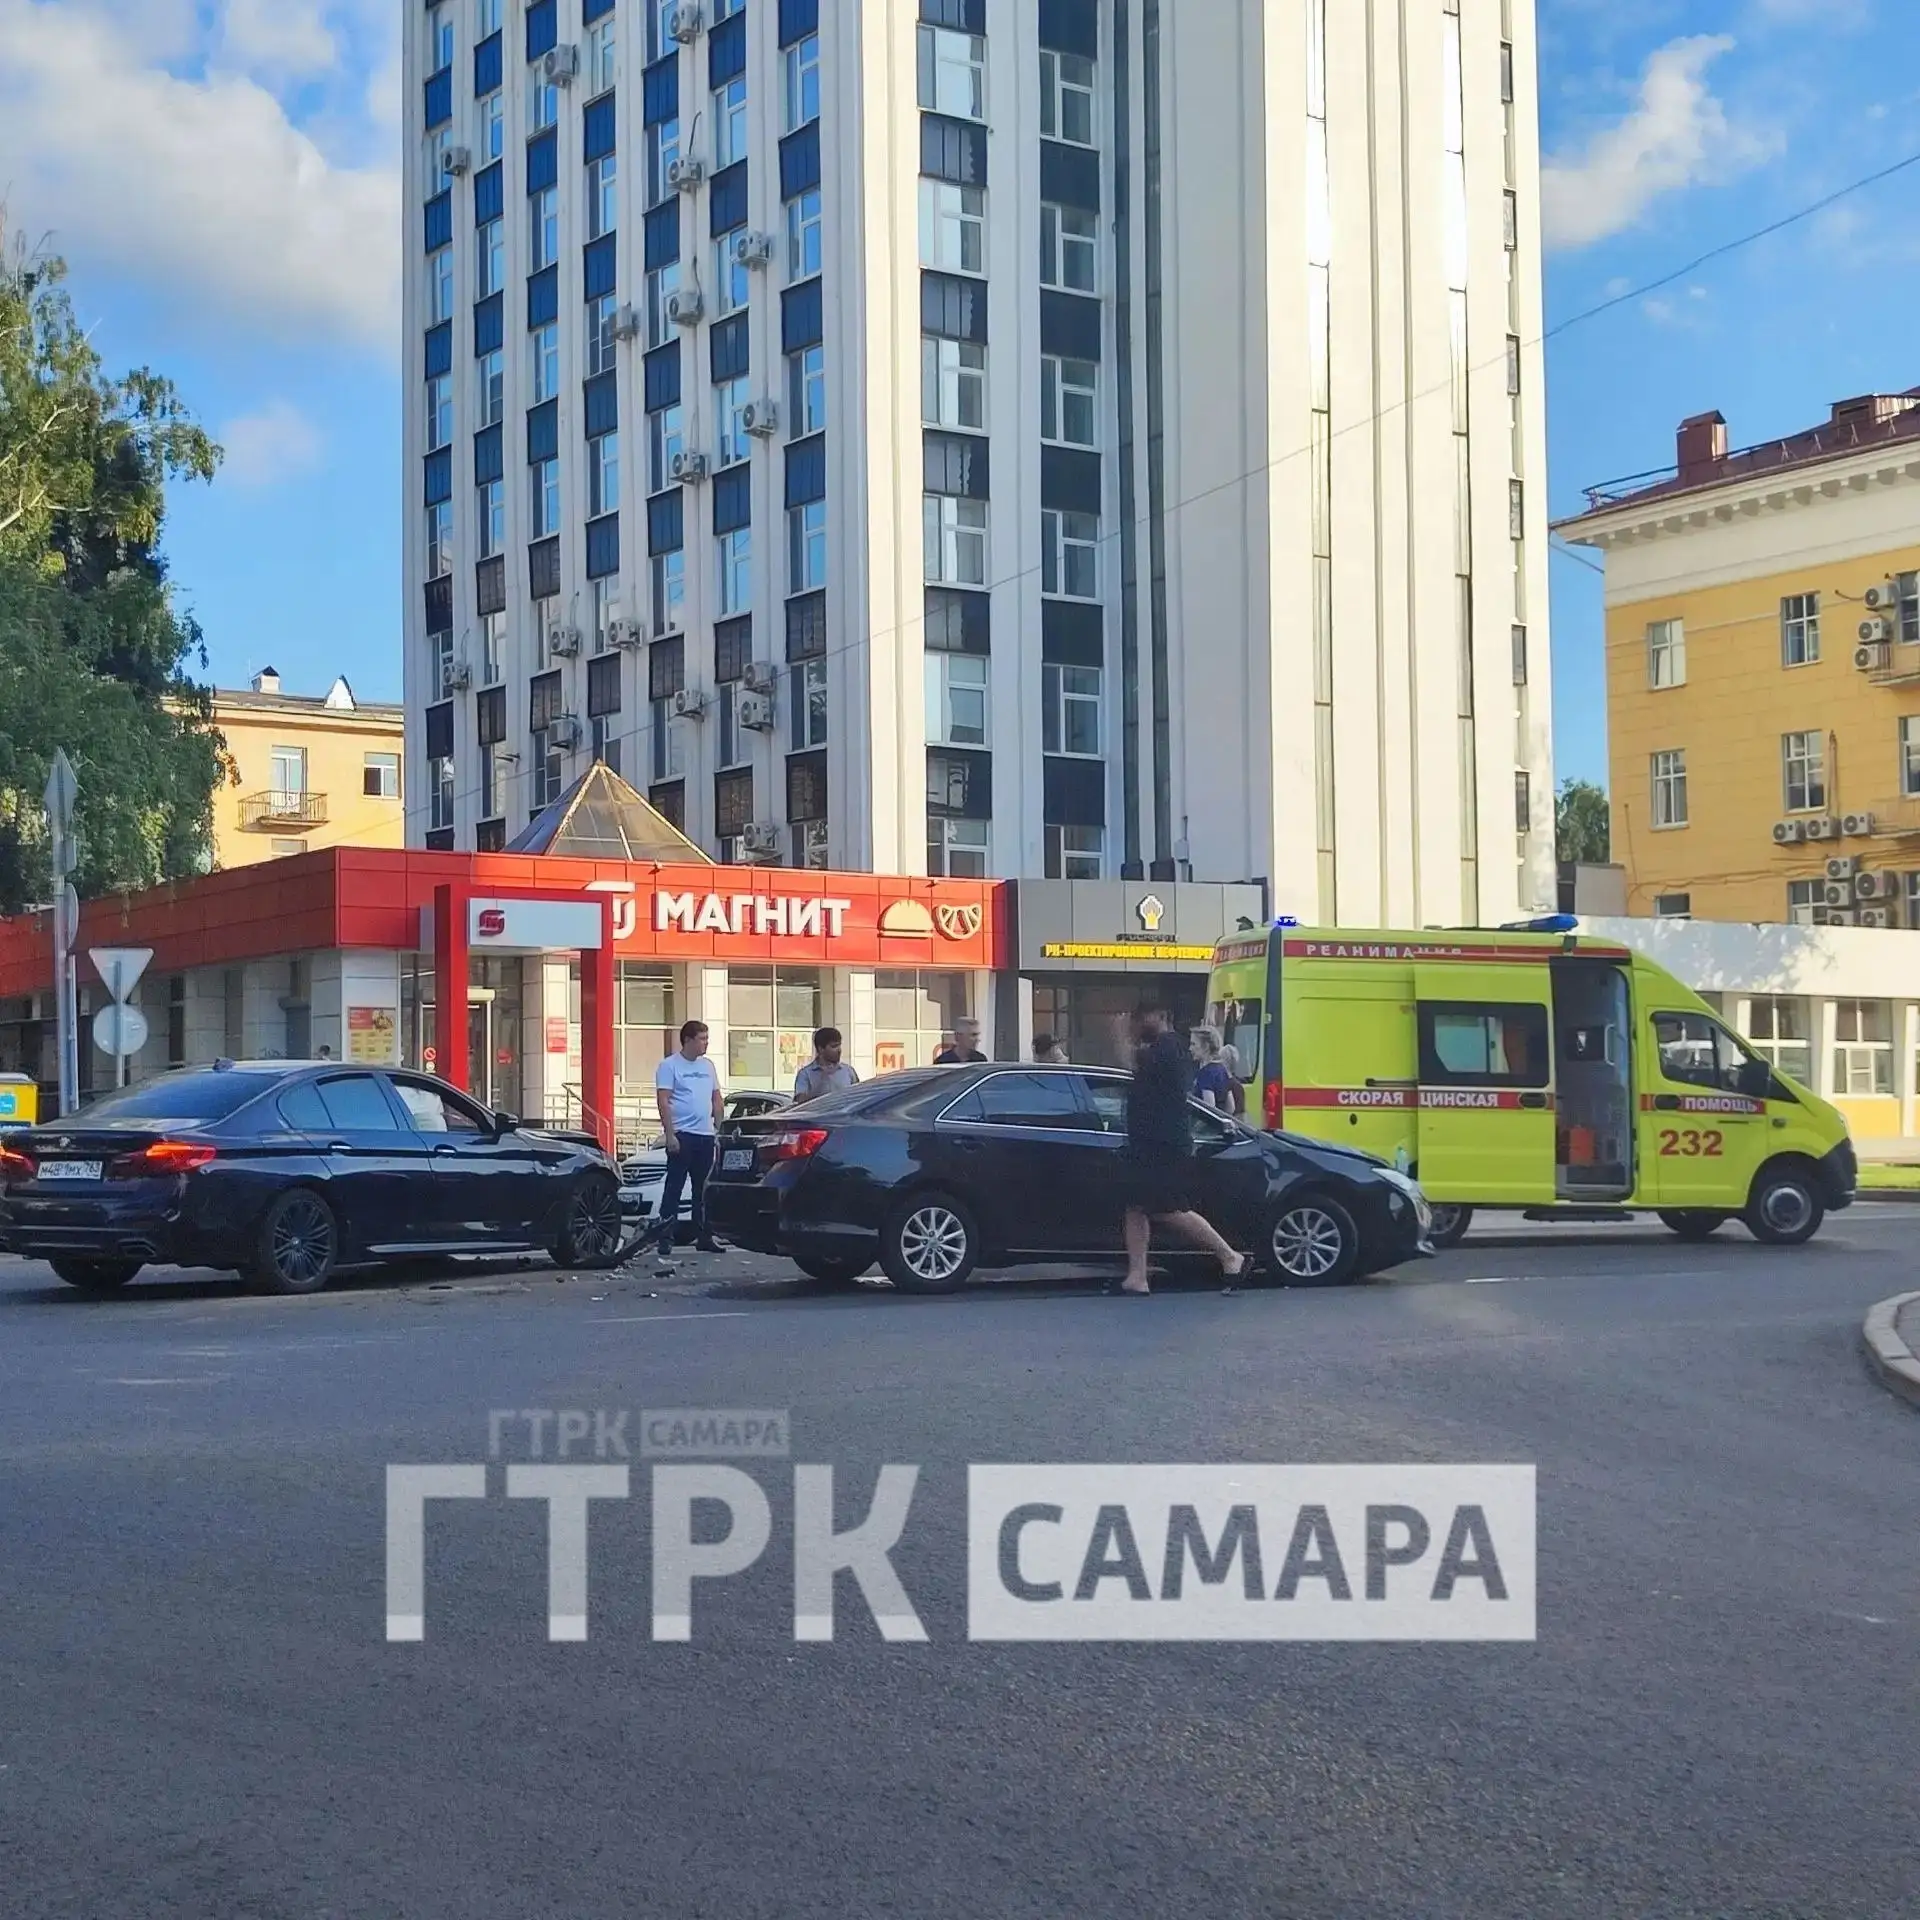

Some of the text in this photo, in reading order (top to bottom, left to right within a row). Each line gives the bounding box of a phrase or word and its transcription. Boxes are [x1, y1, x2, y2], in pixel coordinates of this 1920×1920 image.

[656, 890, 851, 937] МАГНИТ
[1337, 1091, 1404, 1105] СКОРАЯ
[1685, 1097, 1758, 1113] ПОМОЩЬ
[1659, 1129, 1723, 1156] 232
